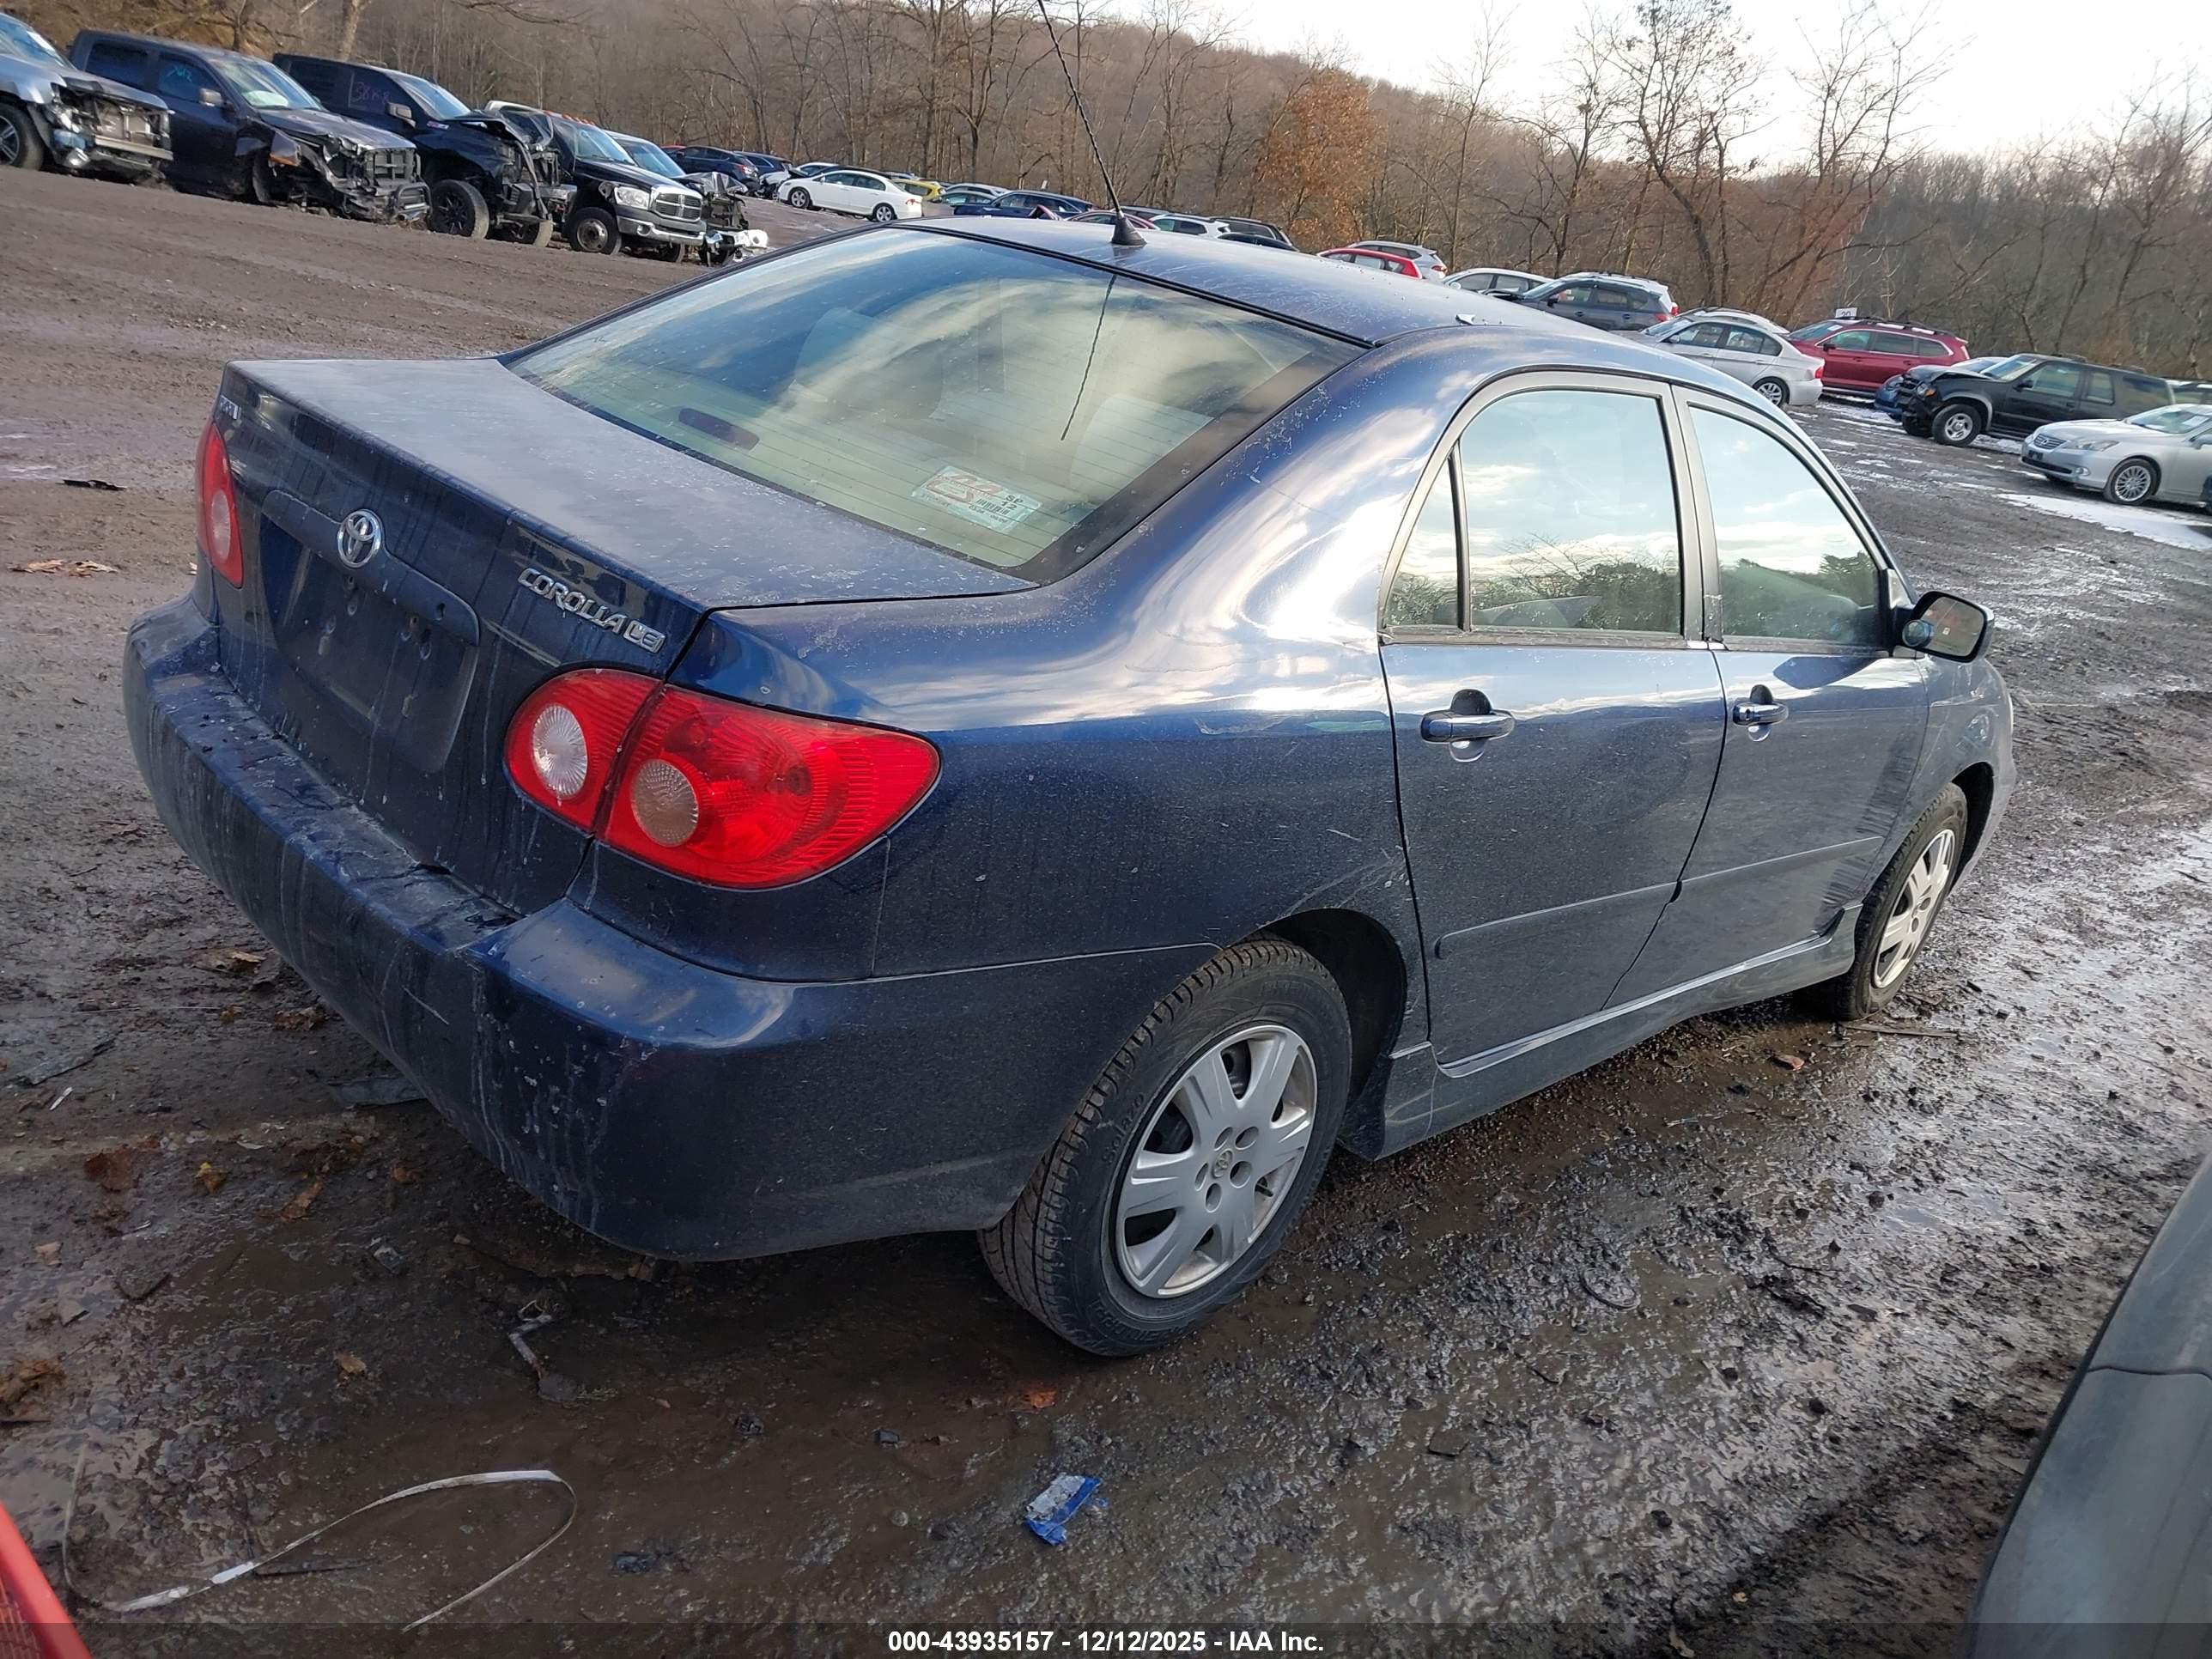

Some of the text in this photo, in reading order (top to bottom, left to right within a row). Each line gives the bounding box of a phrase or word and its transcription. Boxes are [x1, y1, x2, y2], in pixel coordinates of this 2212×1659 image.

[1006, 494, 1024, 505] SP
[1000, 501, 1018, 511] 12
[517, 568, 664, 652] COROLLA LE
